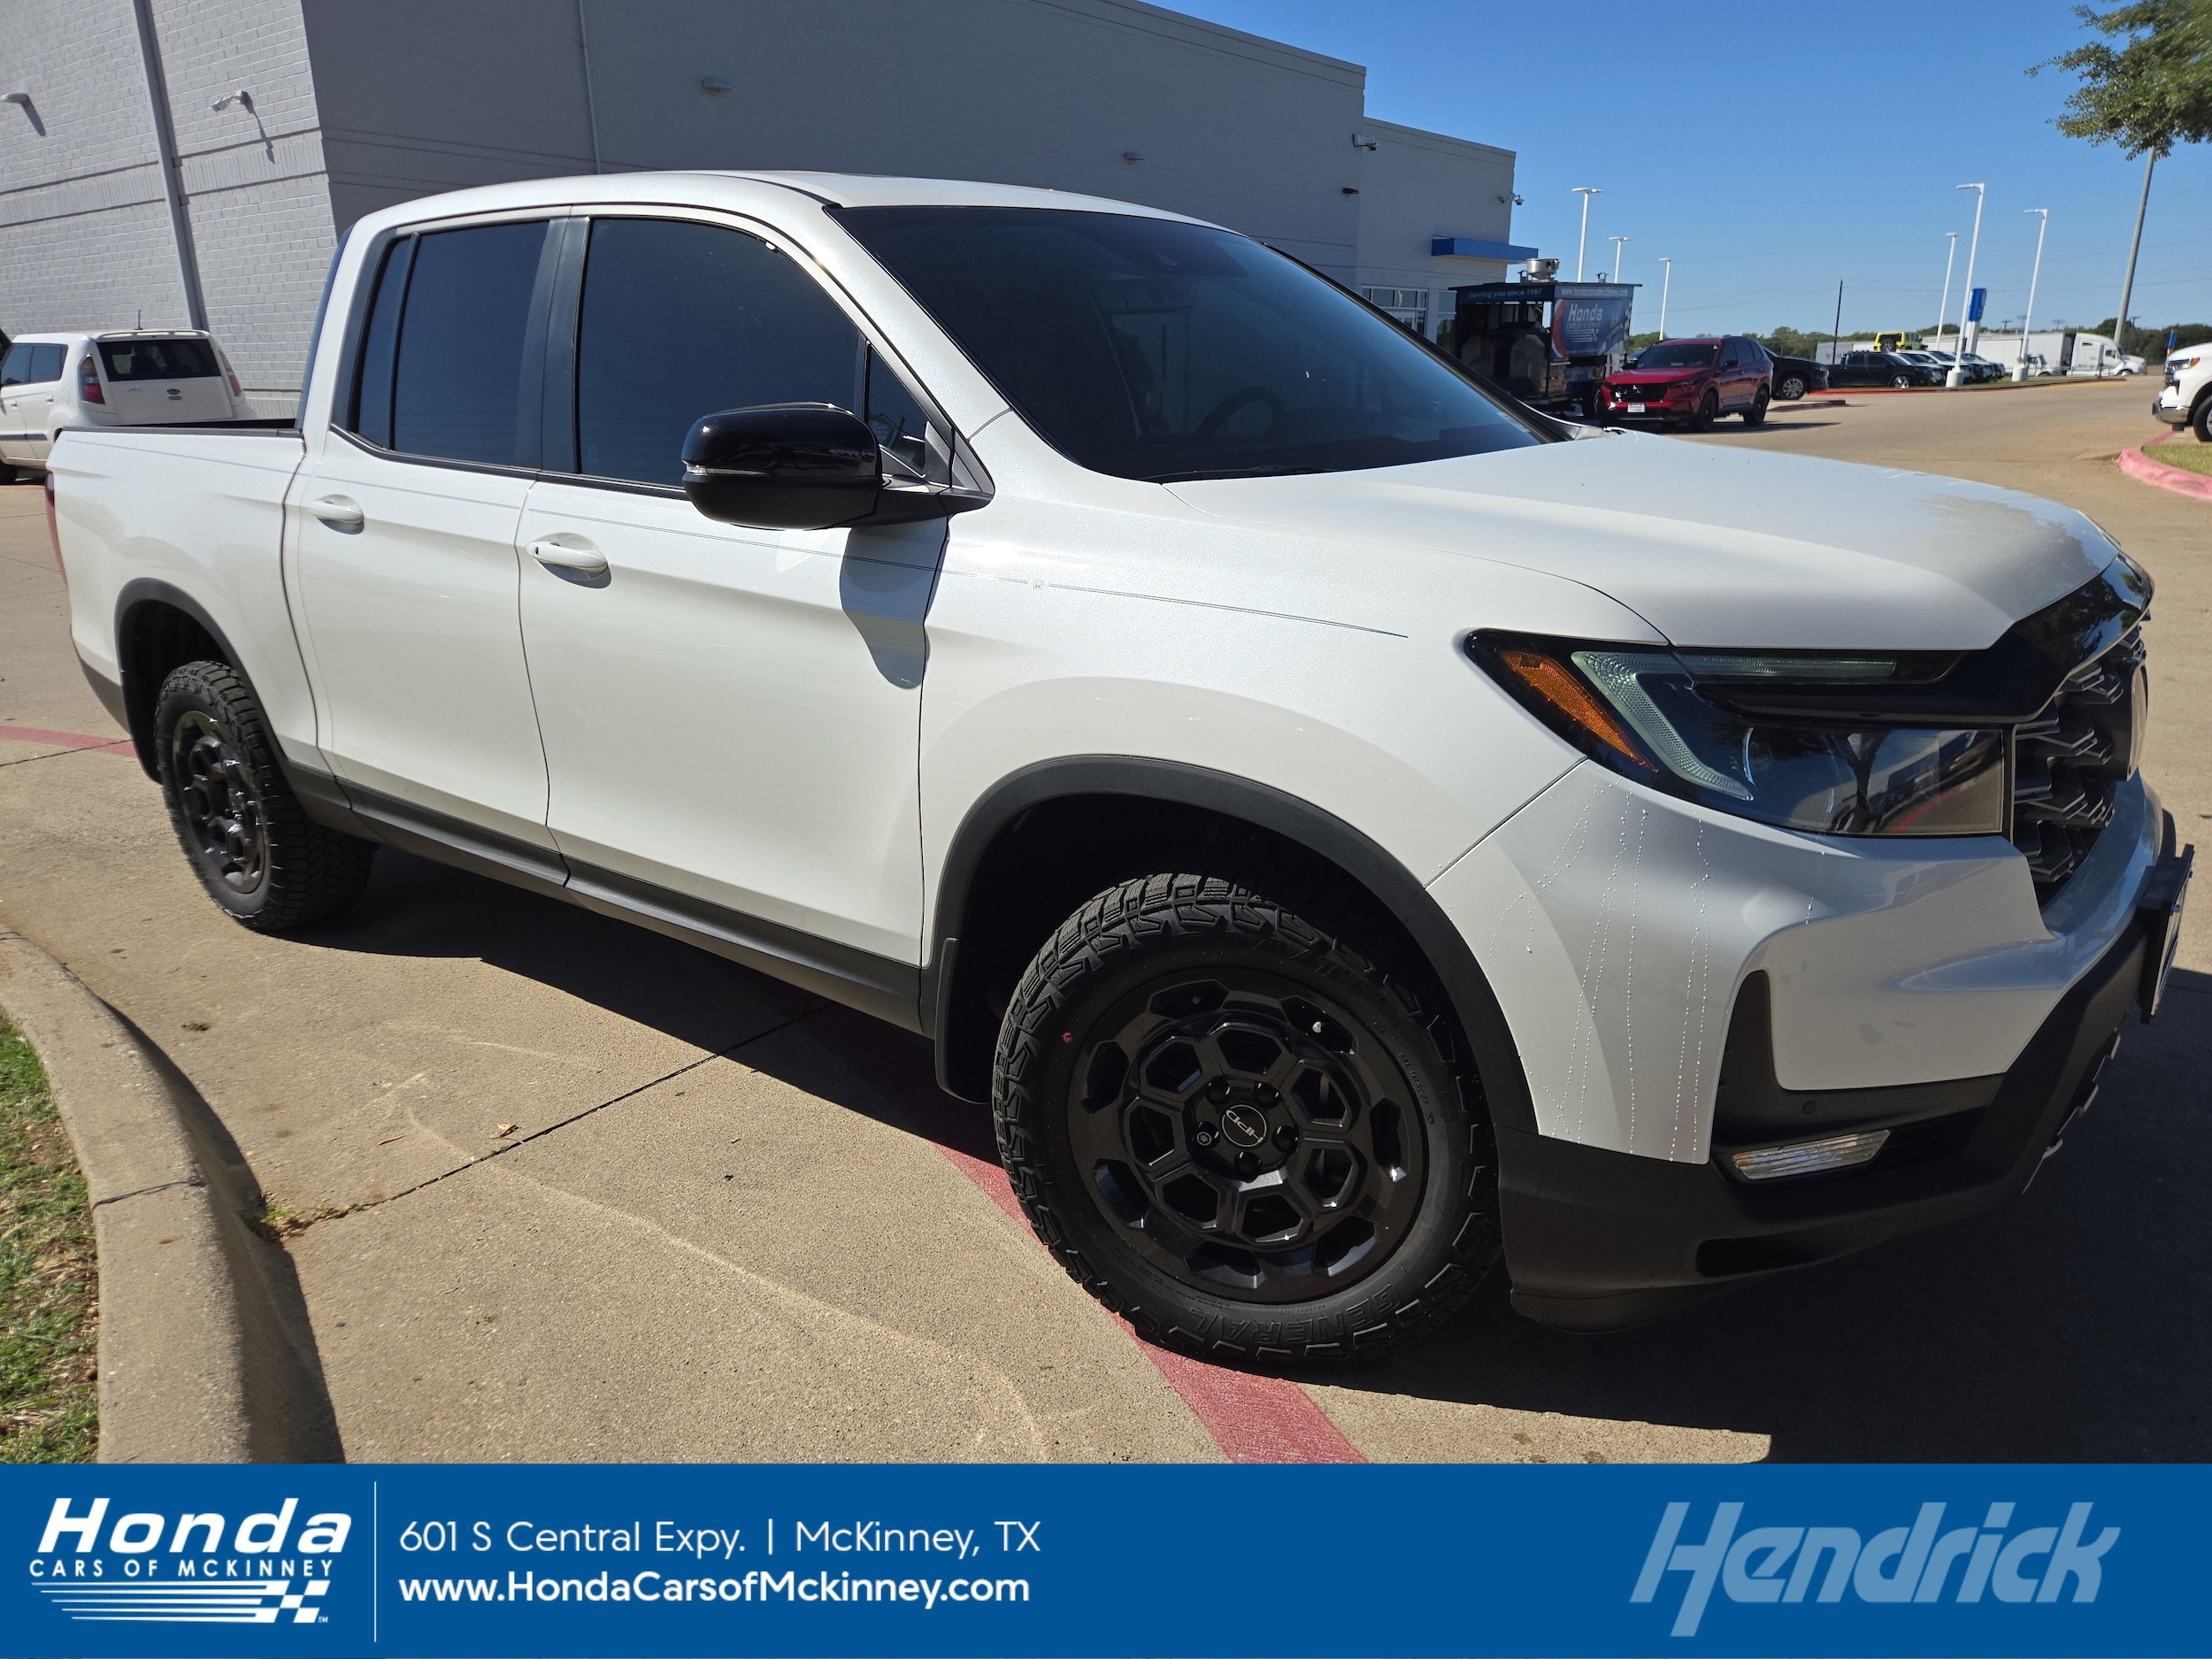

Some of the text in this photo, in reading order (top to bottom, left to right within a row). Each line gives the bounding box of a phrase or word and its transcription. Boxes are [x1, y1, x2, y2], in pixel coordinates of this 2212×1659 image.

[1469, 290, 1493, 299] Serving
[1568, 303, 1603, 321] Honda
[1189, 1283, 1403, 1344] GENERAL
